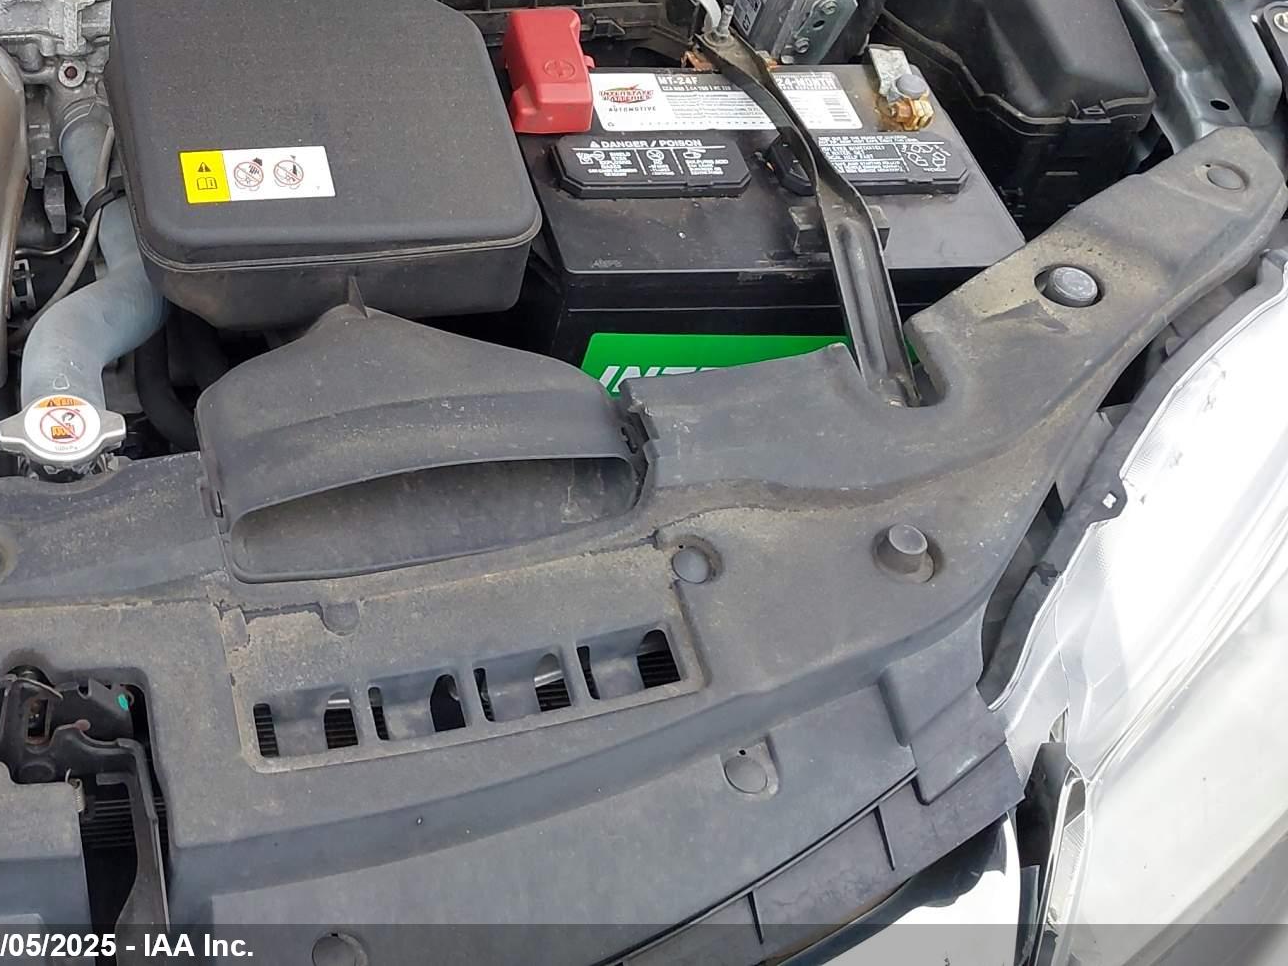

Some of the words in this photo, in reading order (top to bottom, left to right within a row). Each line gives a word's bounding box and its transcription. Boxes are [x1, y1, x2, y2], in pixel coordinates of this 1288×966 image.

[658, 76, 698, 85] MT-24F
[601, 140, 648, 148] DANGER
[659, 139, 702, 147] POISON
